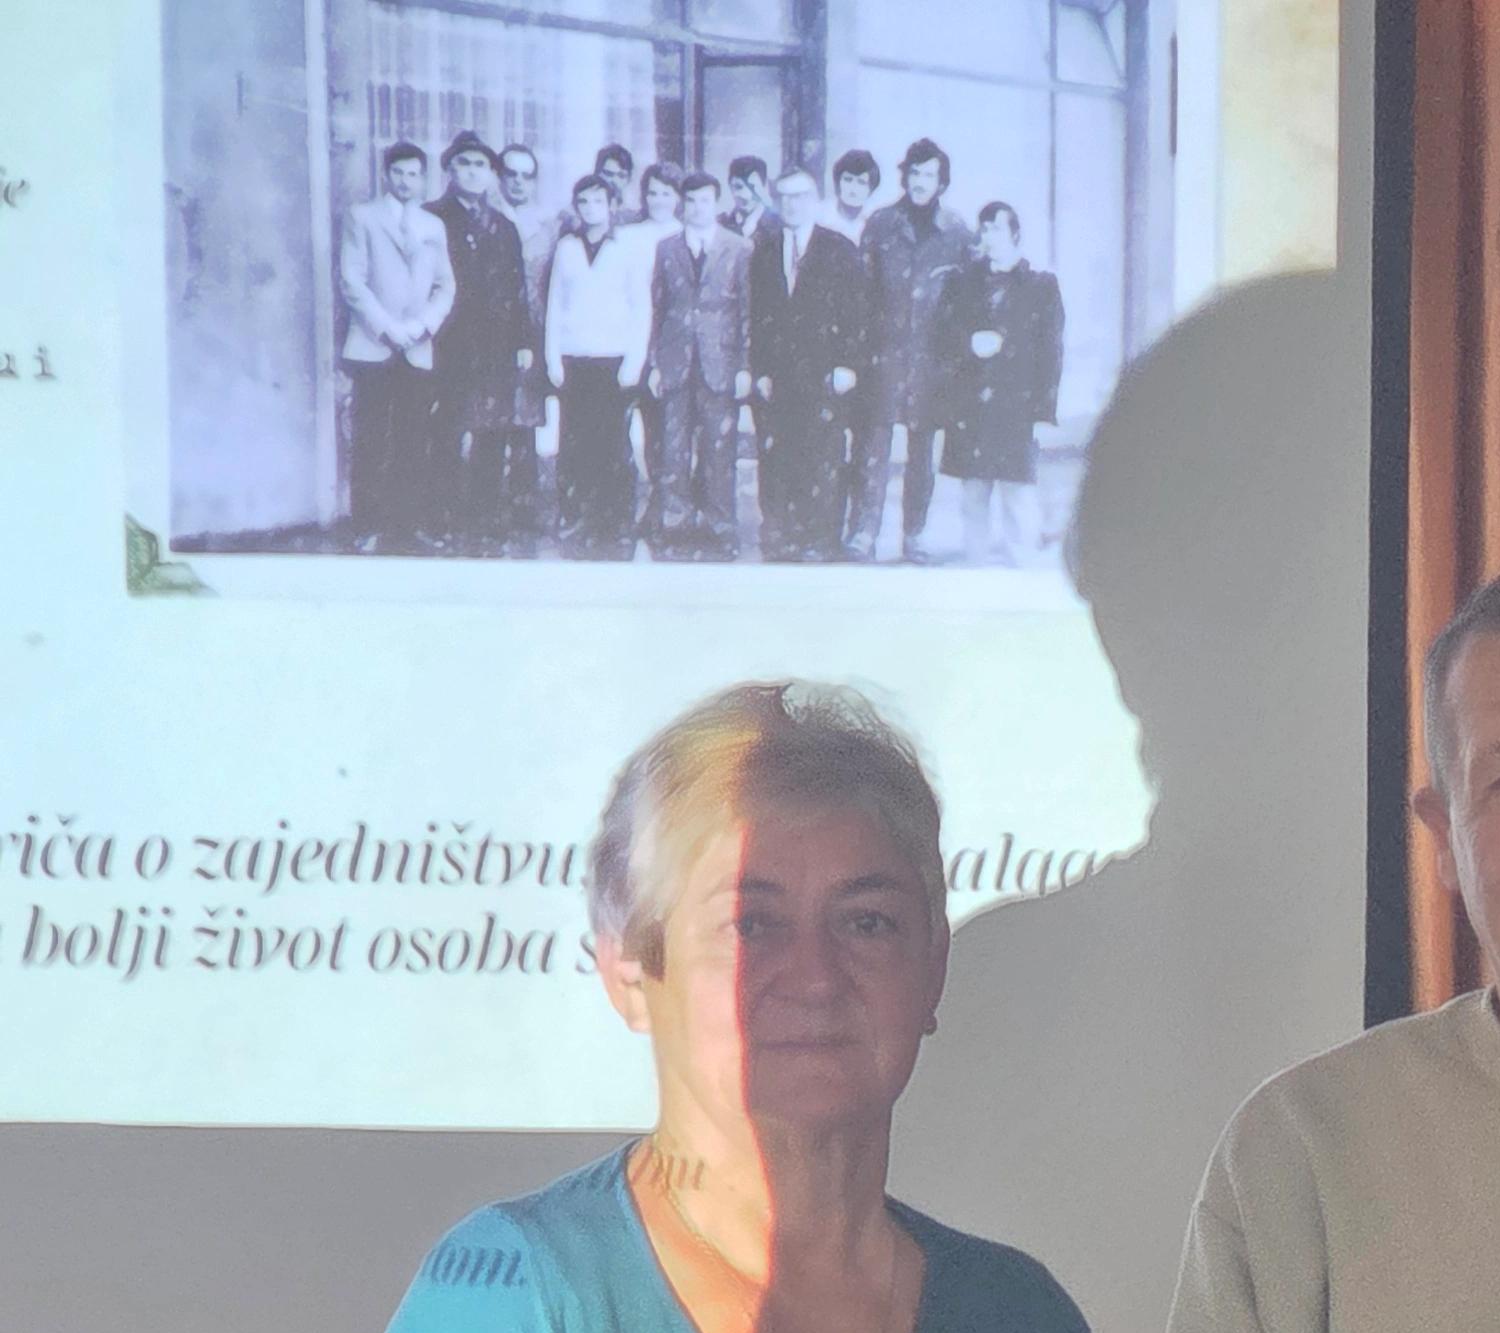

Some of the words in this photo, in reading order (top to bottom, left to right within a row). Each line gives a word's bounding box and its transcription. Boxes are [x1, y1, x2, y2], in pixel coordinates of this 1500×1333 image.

[134, 832, 170, 880] o
[22, 903, 174, 982] bolji
[193, 905, 350, 974] život
[366, 912, 558, 975] osoba
